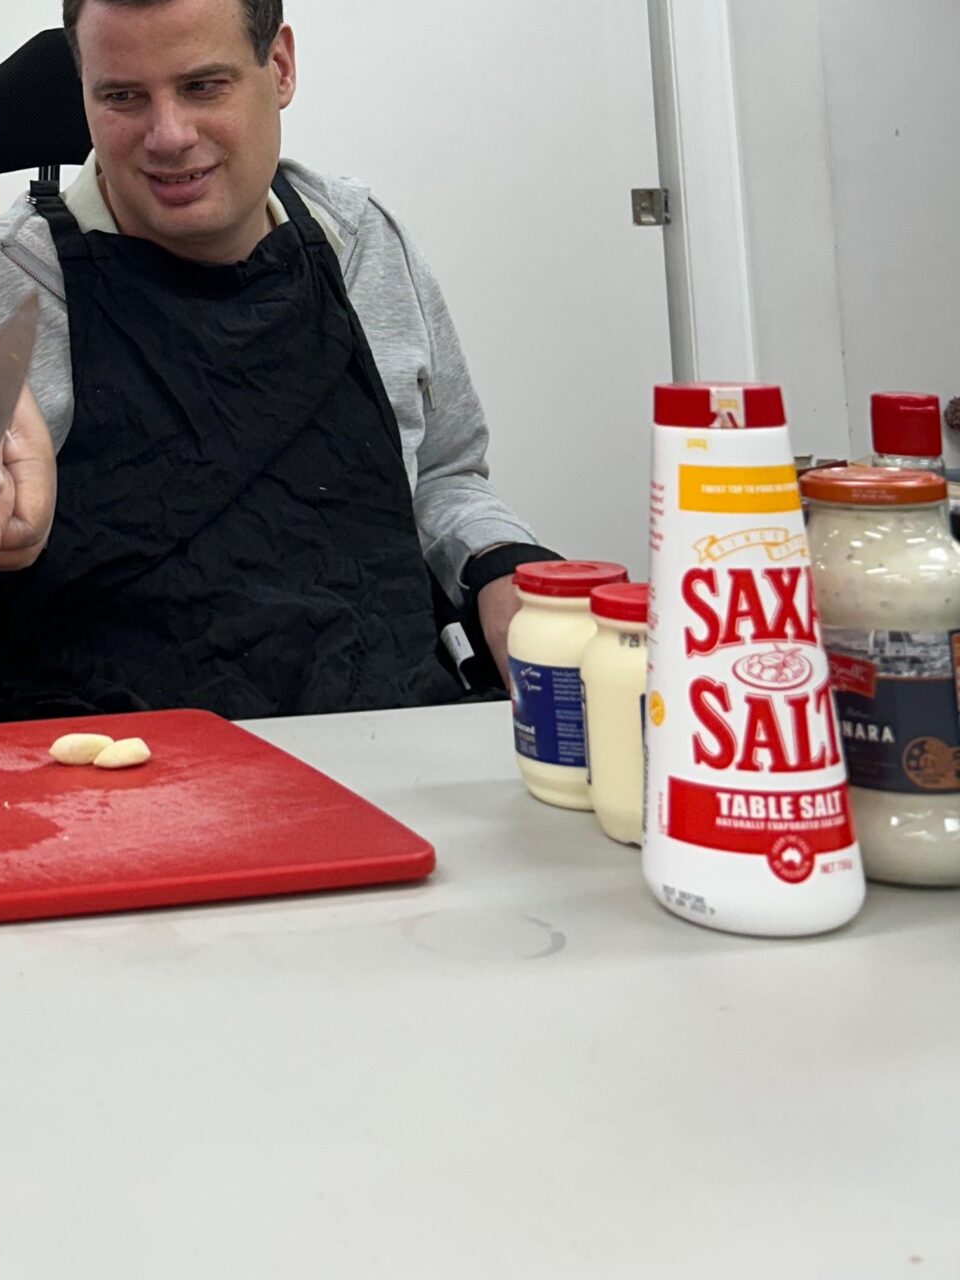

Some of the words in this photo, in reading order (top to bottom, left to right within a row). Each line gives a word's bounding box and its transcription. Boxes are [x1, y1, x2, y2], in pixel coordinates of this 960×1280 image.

[689, 675, 841, 773] SALT
[715, 791, 795, 820] TABLE
[799, 790, 842, 819] SALT
[715, 816, 766, 830] NATURALLY
